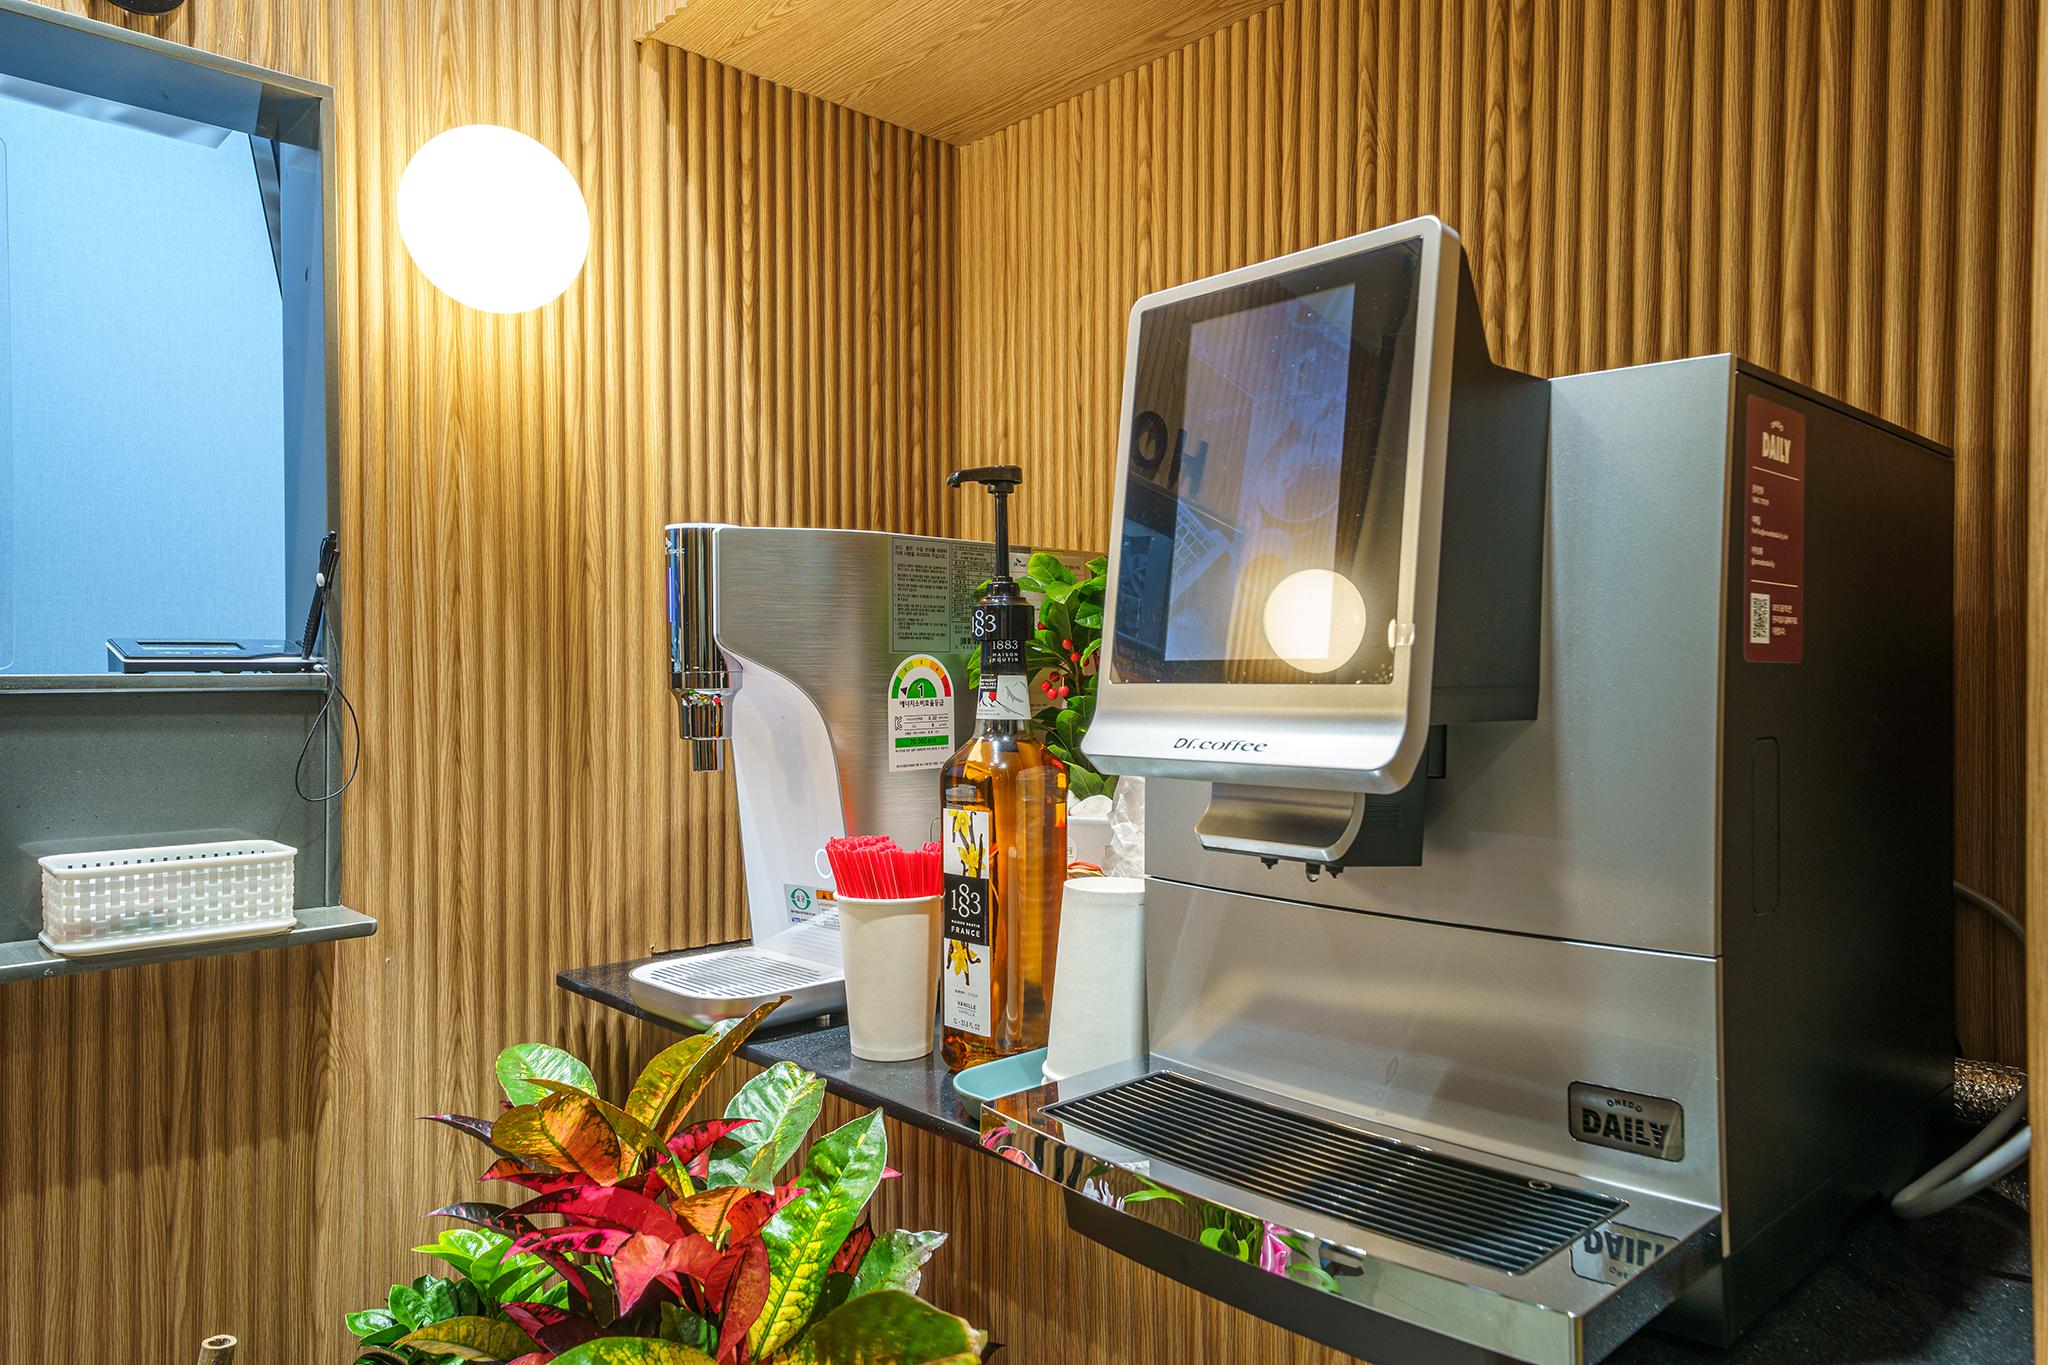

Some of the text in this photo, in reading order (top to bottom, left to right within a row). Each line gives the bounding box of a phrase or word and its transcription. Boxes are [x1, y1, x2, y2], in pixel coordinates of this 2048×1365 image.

[1762, 431, 1791, 464] DAILY
[992, 640, 1019, 650] 1883
[951, 926, 980, 937] FRANCE
[957, 1000, 977, 1010] VANILLE
[1606, 1099, 1643, 1113] ONEDO
[1582, 1107, 1670, 1149] DAILY
